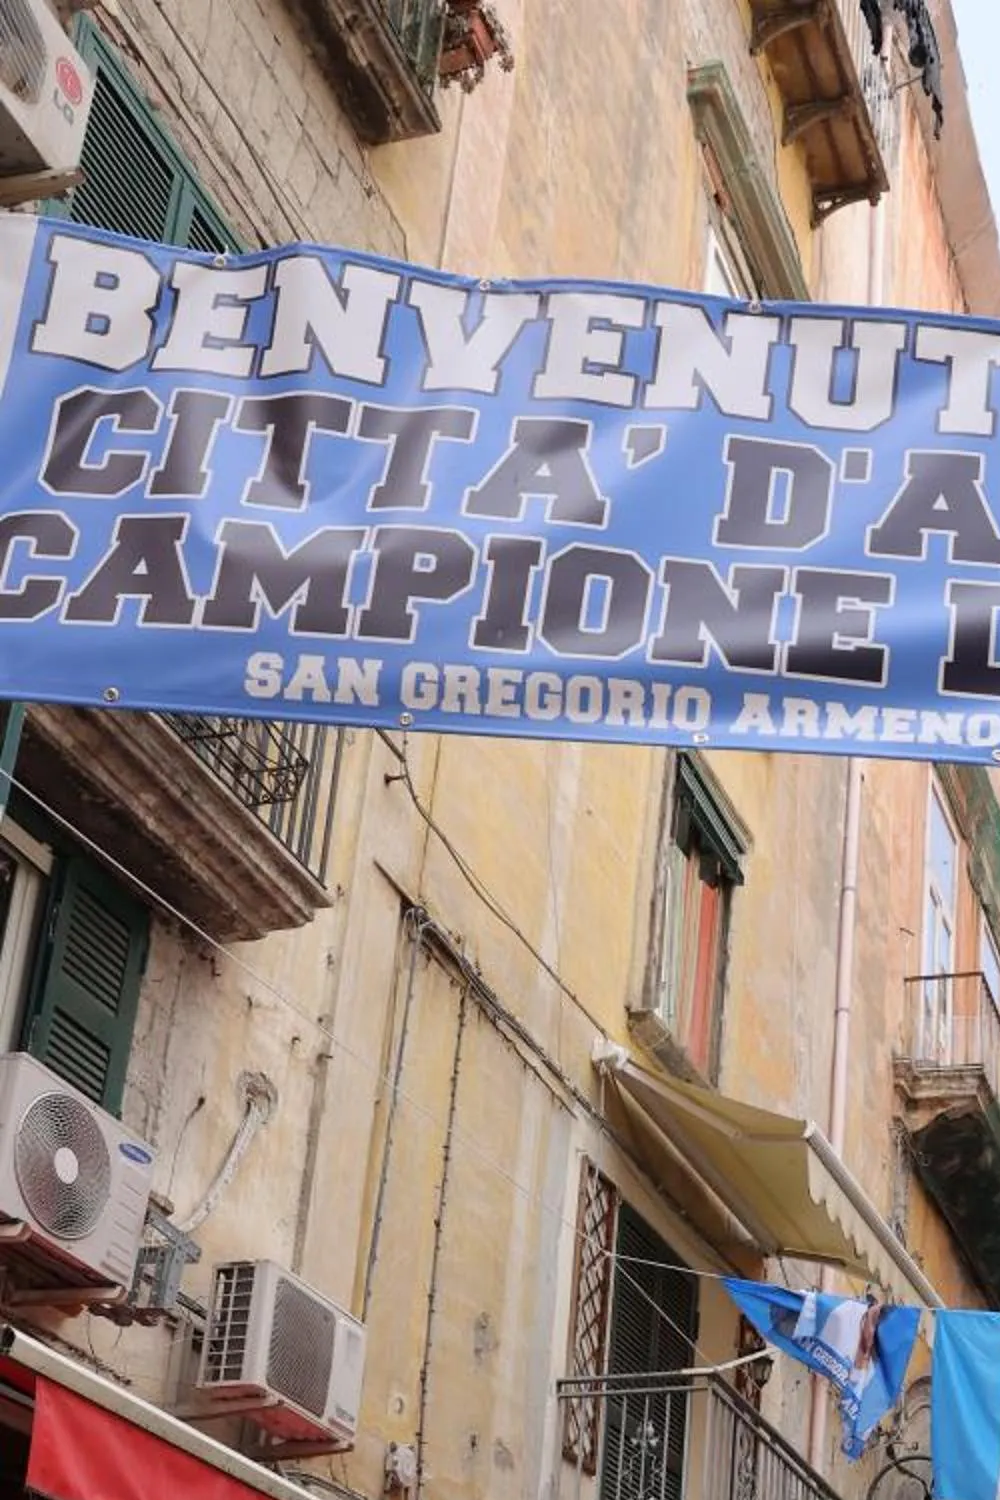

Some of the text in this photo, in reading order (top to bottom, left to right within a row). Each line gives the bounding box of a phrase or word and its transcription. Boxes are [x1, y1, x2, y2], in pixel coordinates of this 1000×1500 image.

[39, 384, 668, 529] CITTA'
[0, 509, 896, 687] CAMPIONE
[245, 652, 382, 707] SAN
[402, 661, 712, 734] GREGORIO
